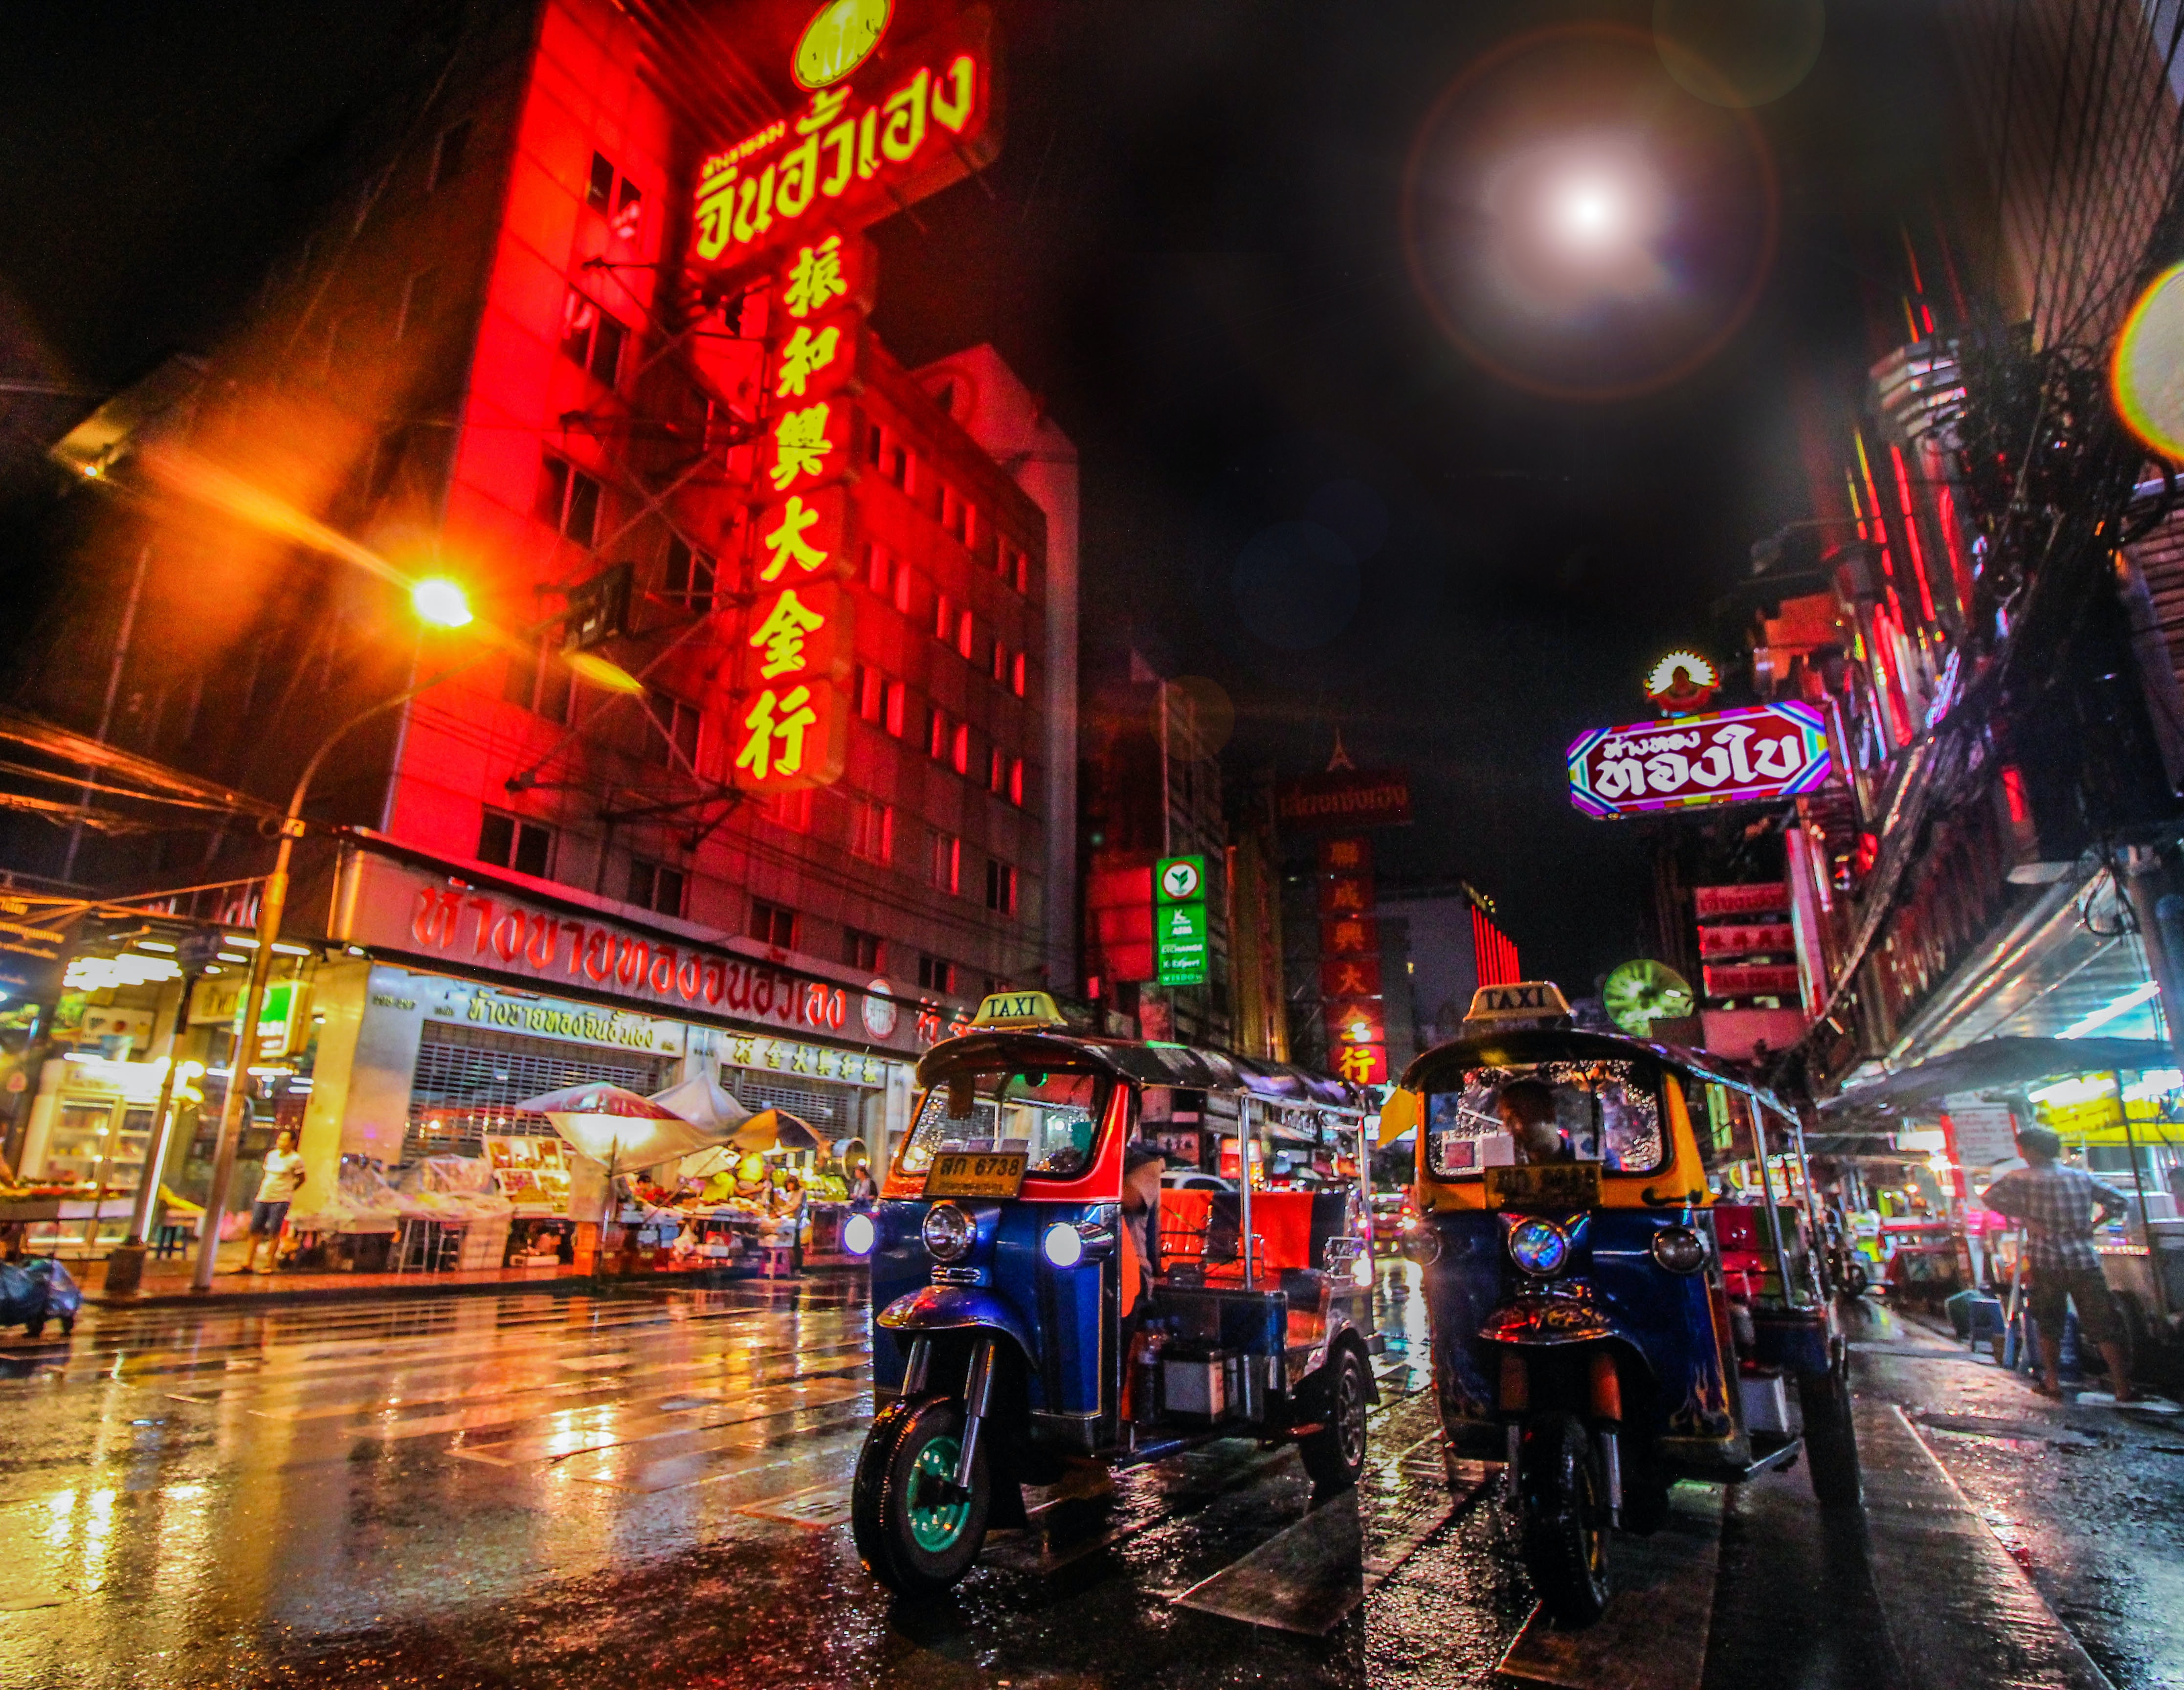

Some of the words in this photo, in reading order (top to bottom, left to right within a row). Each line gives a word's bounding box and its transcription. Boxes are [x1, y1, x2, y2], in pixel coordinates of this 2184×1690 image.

[735, 235, 848, 779] 振和興大金行
[1604, 730, 1701, 759] ห้างทอง
[1595, 724, 1802, 799] ทองใบ
[988, 996, 1036, 1018] TAXI
[1481, 987, 1544, 1010] TAXI
[974, 1157, 1020, 1176] 6738
